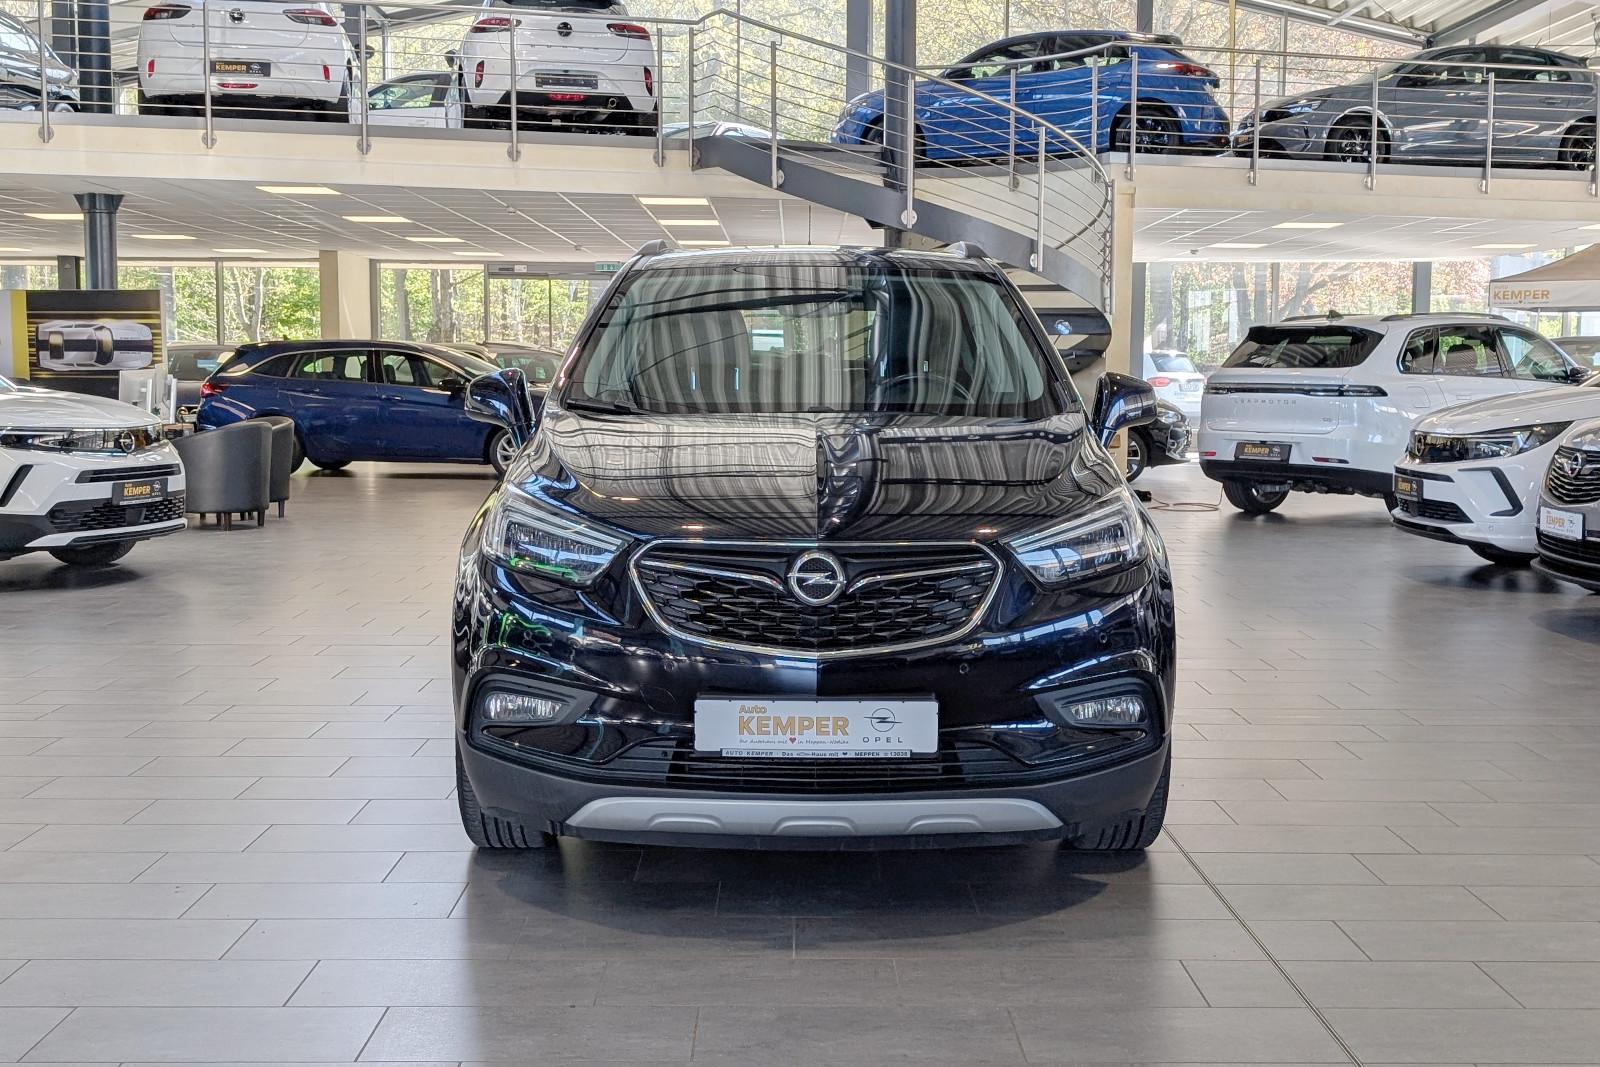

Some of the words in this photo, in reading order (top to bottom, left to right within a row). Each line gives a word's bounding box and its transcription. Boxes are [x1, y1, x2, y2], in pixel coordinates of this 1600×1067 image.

[1493, 289, 1550, 300] KEMPER
[124, 486, 150, 496] KEMPER
[739, 705, 767, 714] Auto
[738, 716, 849, 736] KEMPER
[862, 736, 903, 744] OPEL
